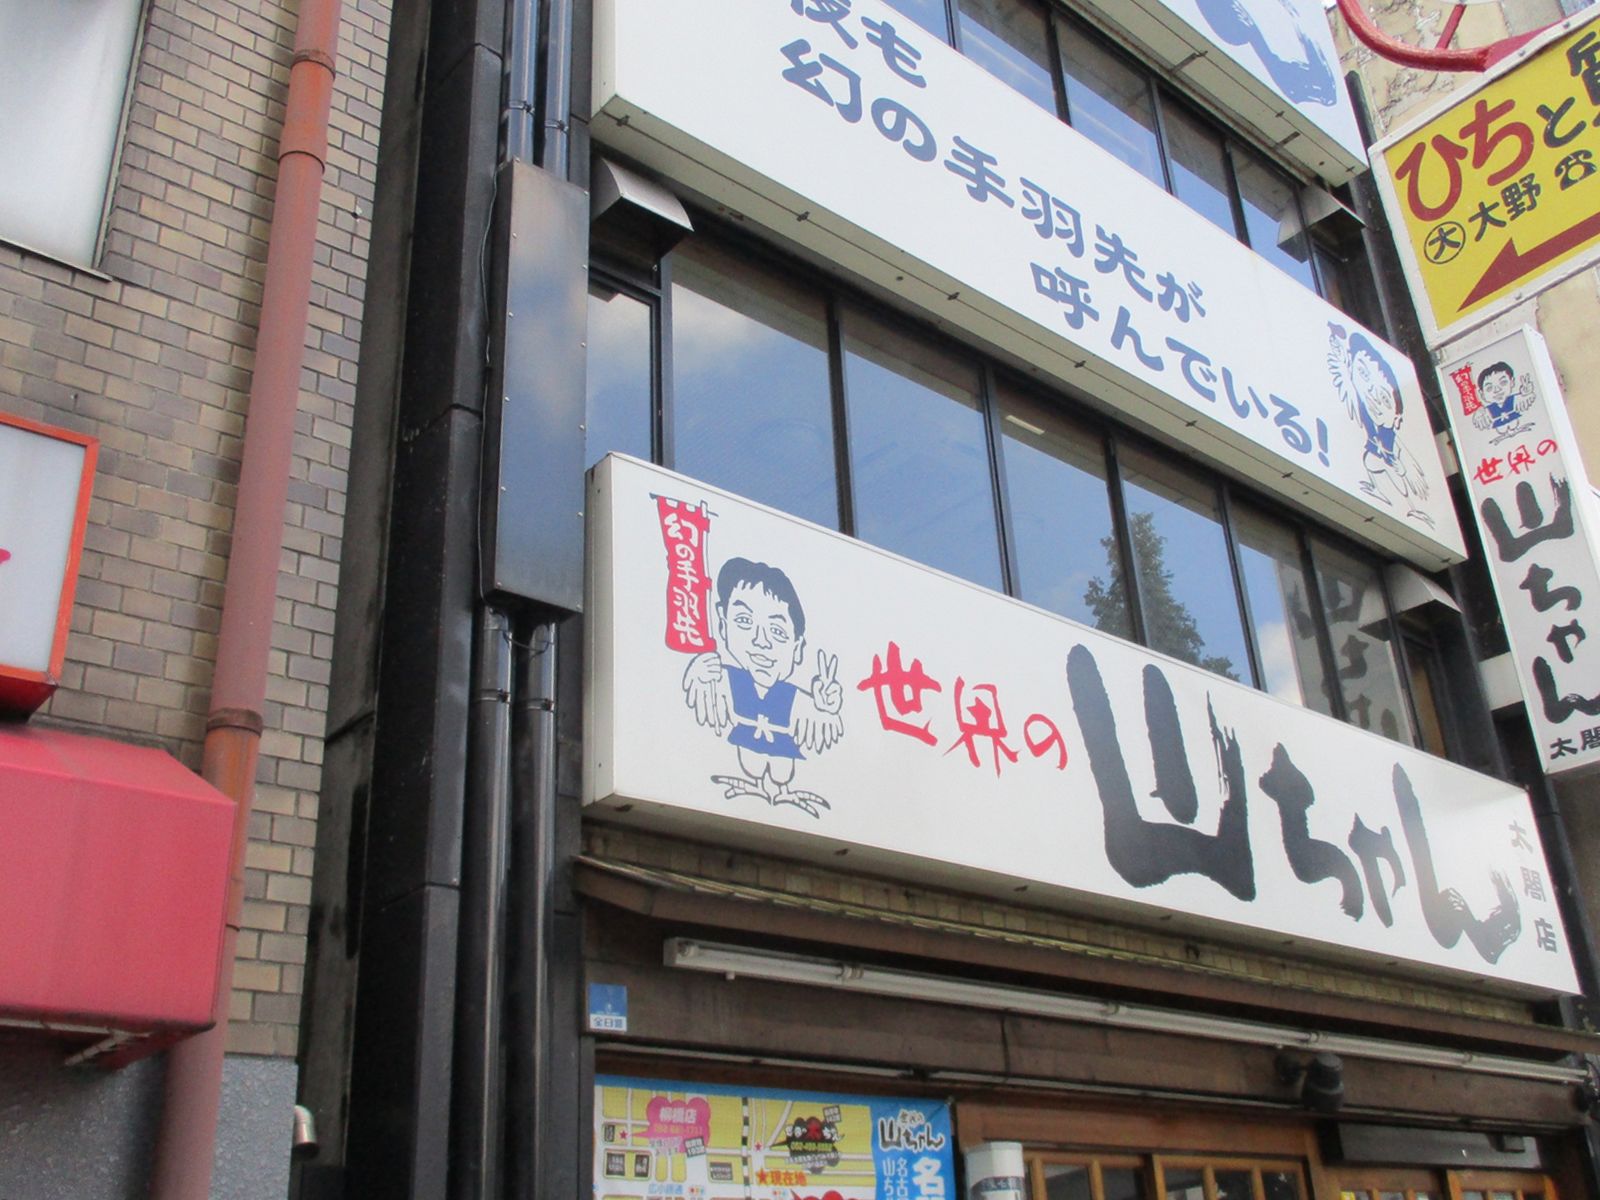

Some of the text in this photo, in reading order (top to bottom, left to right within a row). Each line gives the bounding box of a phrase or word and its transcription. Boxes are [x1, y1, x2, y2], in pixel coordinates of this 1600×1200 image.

[780, 38, 1206, 323] 幻の手羽先が
[1468, 173, 1541, 242] 大野
[1030, 262, 1330, 468] 呼んでいる!
[1473, 439, 1558, 485] 世界の
[1480, 471, 1600, 724] 山ちゃん
[857, 641, 1068, 778] 世界の
[1067, 643, 1521, 965] 山ちゃん
[882, 1157, 895, 1200] 山ち
[896, 1157, 909, 1200] 名古
[912, 1157, 946, 1200] 名
